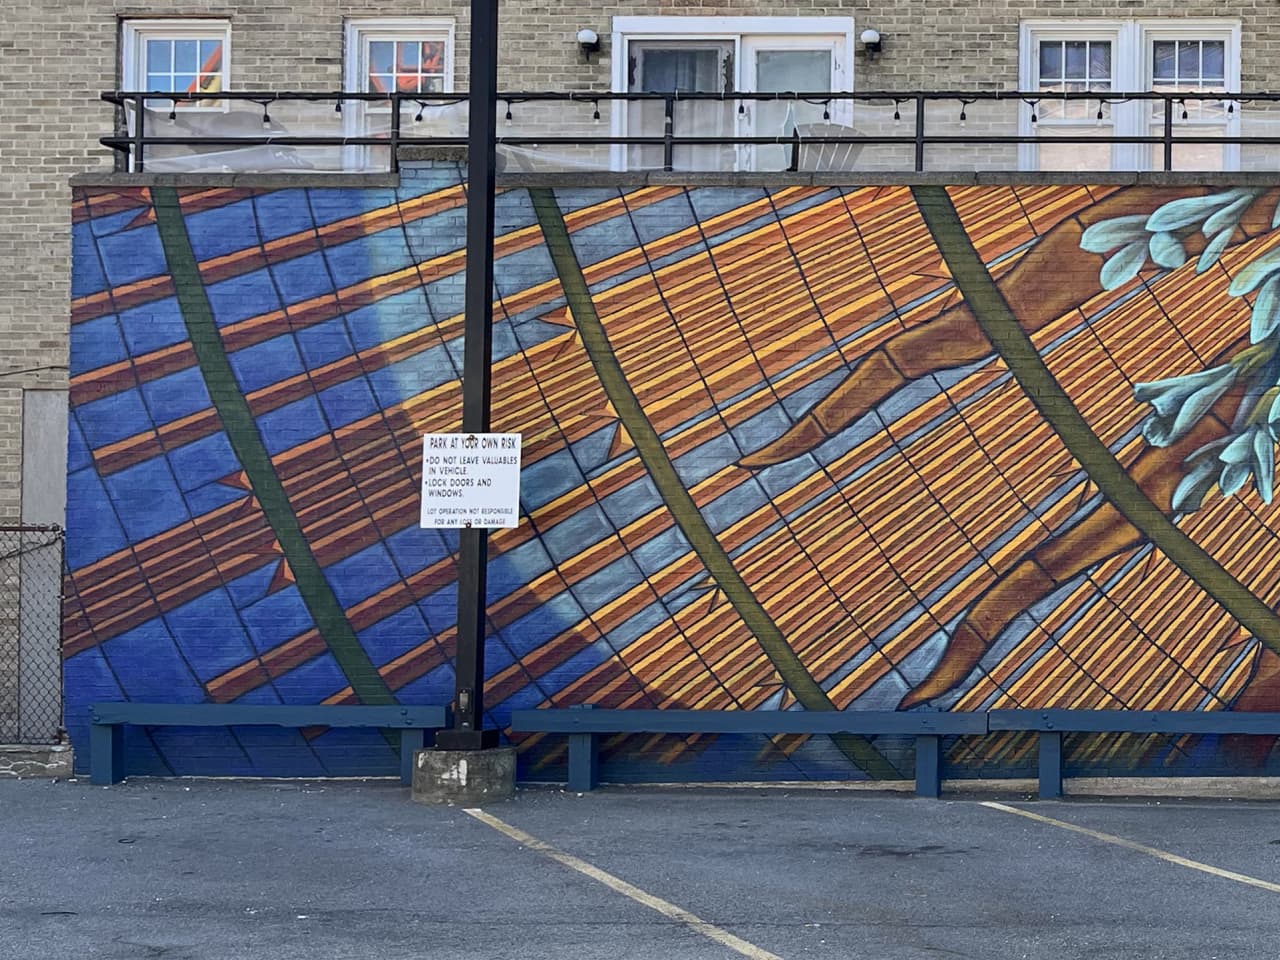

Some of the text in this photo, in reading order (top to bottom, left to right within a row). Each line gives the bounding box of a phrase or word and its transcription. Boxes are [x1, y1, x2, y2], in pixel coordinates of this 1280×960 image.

[430, 438, 516, 449] PARK AT YOUR OWN RISK
[482, 456, 517, 464] VALUABLES
